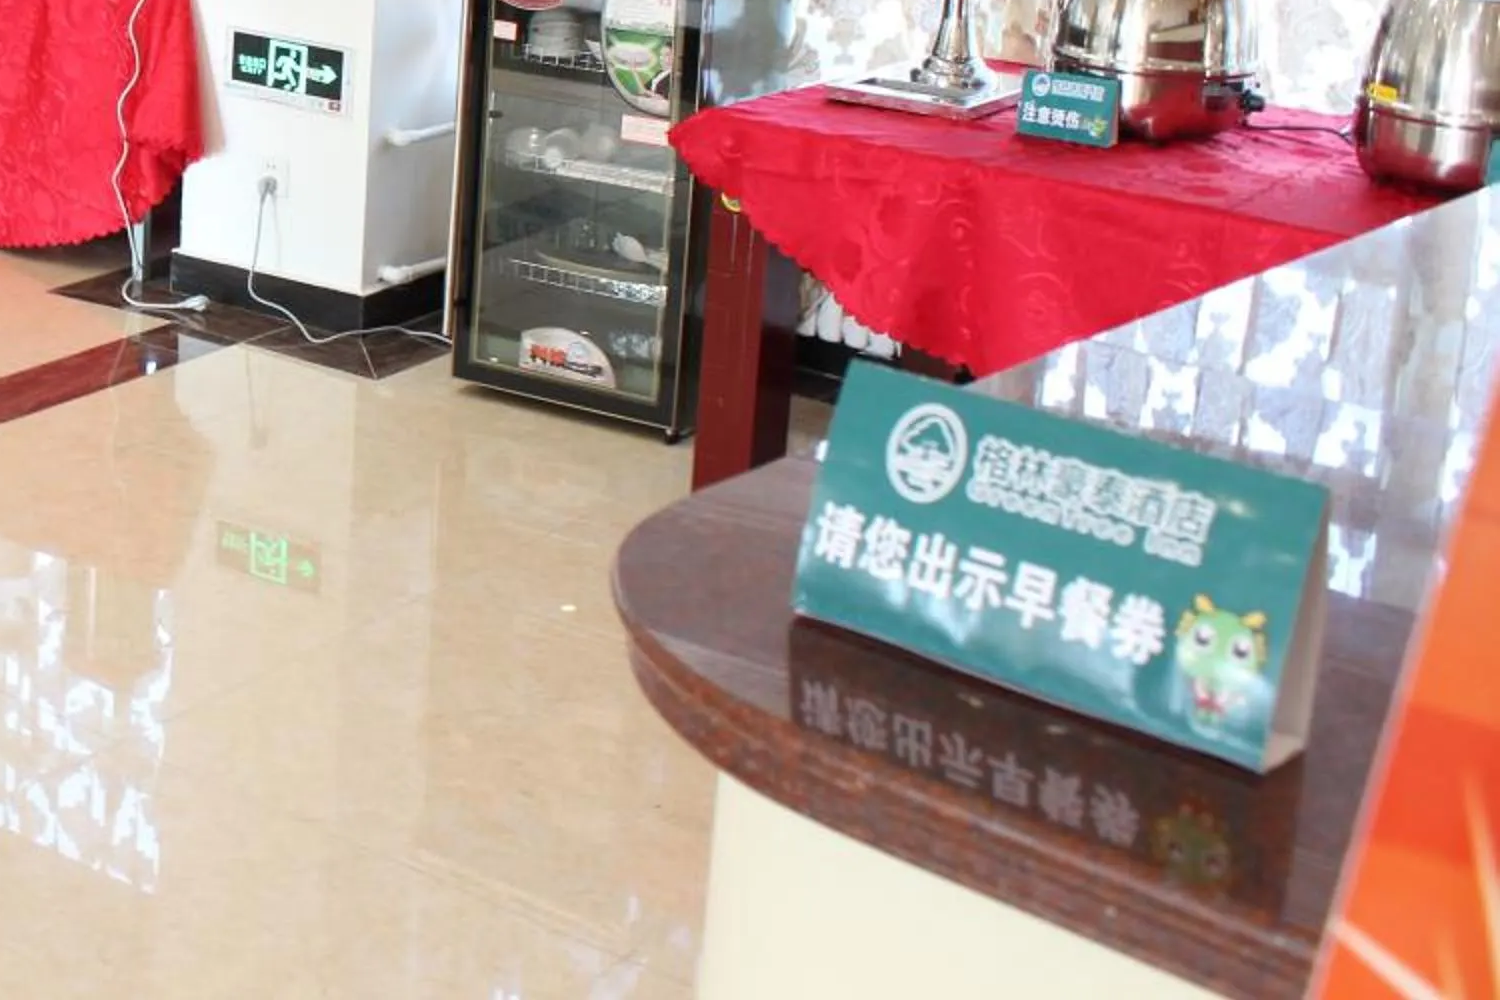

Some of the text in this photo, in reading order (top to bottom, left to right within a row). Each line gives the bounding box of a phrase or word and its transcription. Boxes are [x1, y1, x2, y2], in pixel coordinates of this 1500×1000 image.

[816, 500, 1167, 665] 请您出示早餐券
